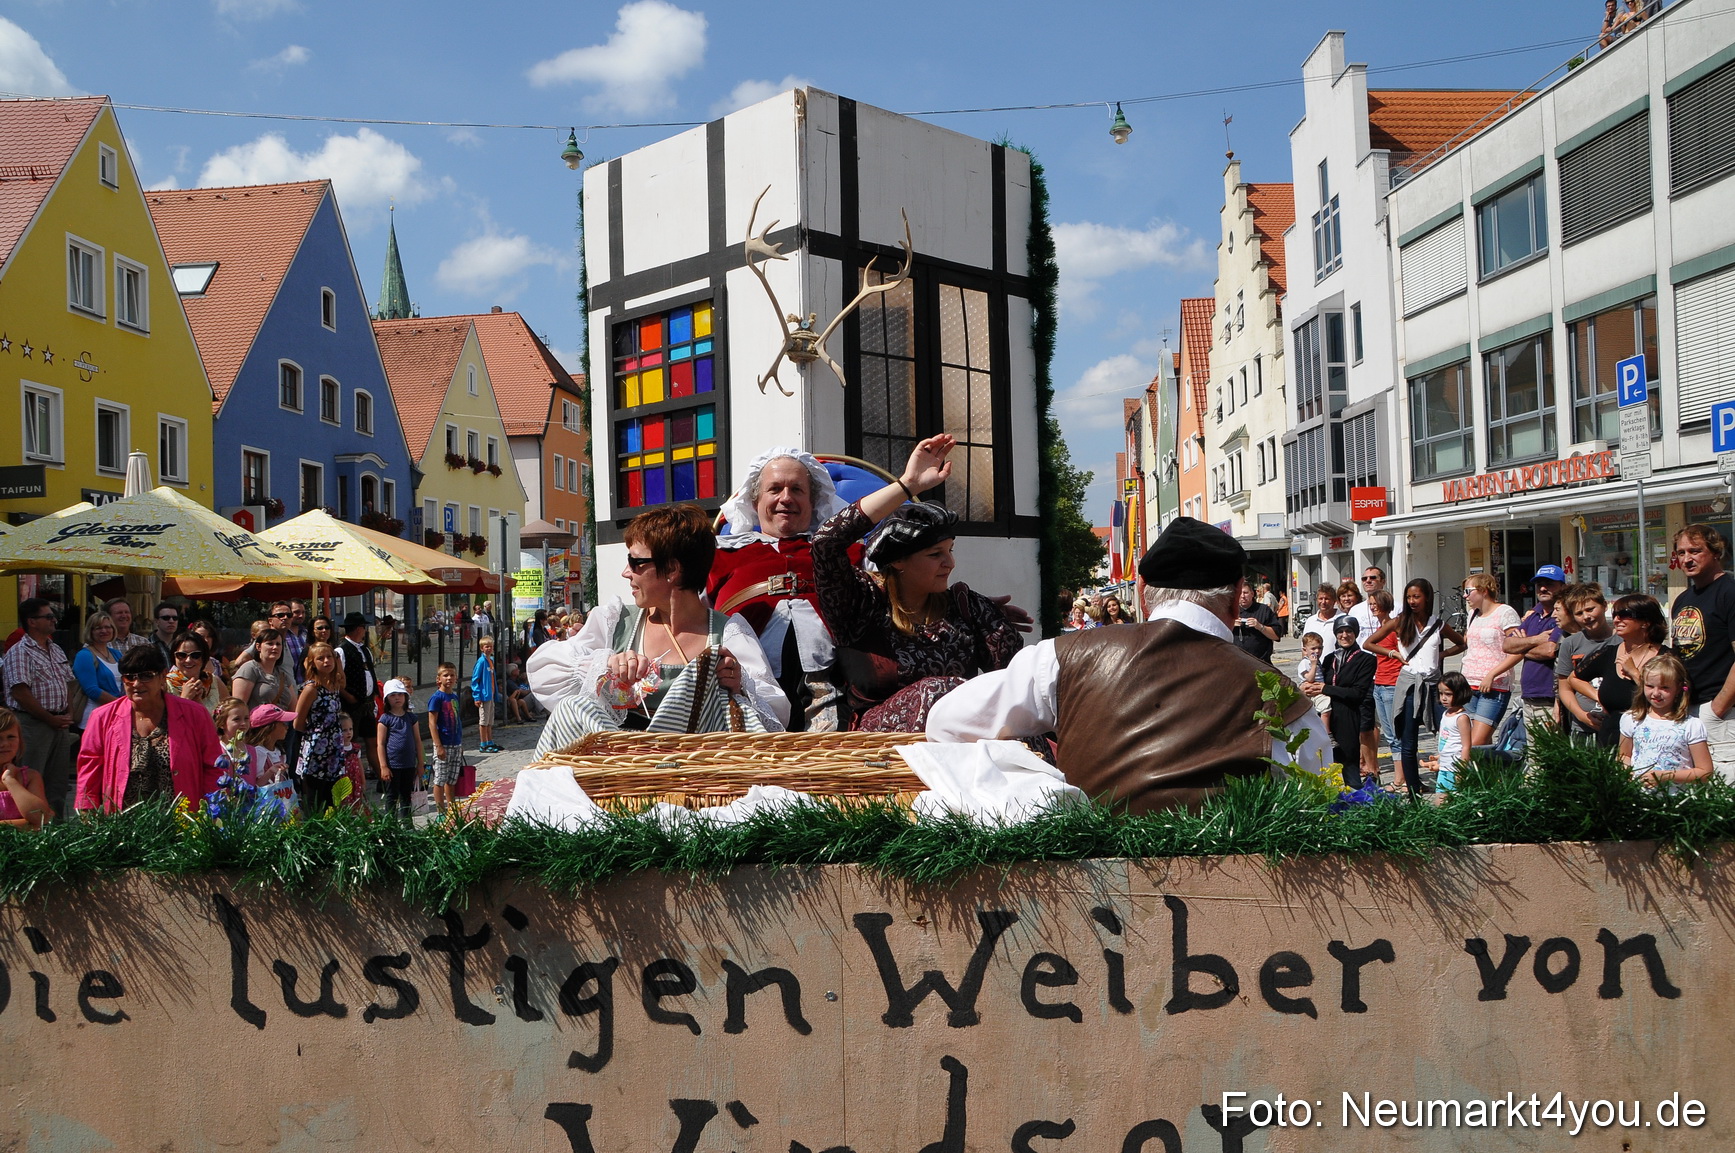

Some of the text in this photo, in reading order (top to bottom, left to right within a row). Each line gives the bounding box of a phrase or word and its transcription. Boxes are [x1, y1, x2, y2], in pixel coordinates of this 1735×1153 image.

[1622, 363, 1639, 400] P
[1621, 415, 1646, 427] Parkschein
[1718, 407, 1735, 446] P
[1623, 424, 1645, 434] werktags
[1442, 450, 1615, 503] MARIEN-APOTHEKE
[1, 485, 42, 494] TAIFUN
[1354, 499, 1385, 508] ESPRIT
[445, 510, 452, 529] P
[47, 523, 176, 544] Glossner
[101, 535, 157, 549] Bier
[270, 541, 343, 552] ossner
[294, 551, 335, 563] Bier
[0, 893, 1683, 1073] ie lustigen Weiber von
